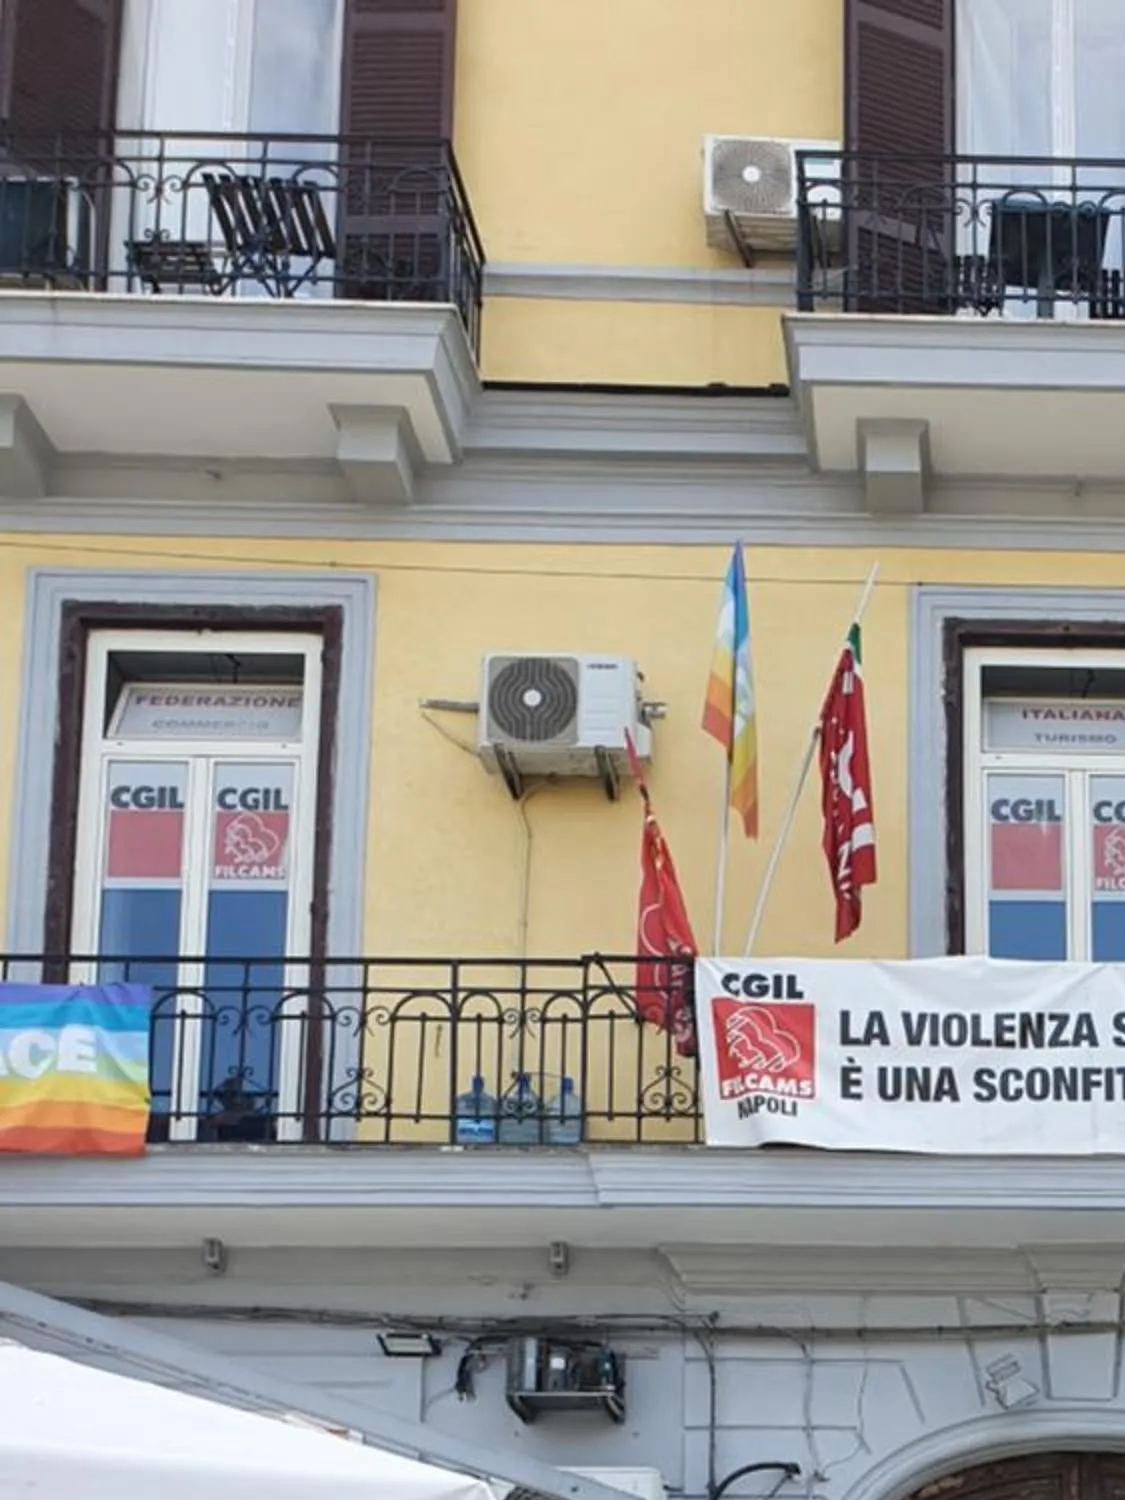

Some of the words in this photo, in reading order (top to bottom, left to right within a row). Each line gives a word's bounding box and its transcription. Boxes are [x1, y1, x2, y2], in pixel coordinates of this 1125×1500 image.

[135, 695, 302, 708] FEDERAZIONE
[1034, 732, 1118, 743] TURISMO
[110, 785, 185, 810] CGIL
[216, 788, 290, 811] CGIL
[991, 798, 1062, 822] CGIL
[214, 864, 286, 878] FILCAMS
[721, 973, 805, 1000] CGIL
[840, 1010, 891, 1047] LA
[902, 1011, 1100, 1049] VIOLENZA
[722, 1073, 815, 1098] FILCAMS
[841, 1056, 864, 1101] È
[877, 1066, 960, 1101] UNA
